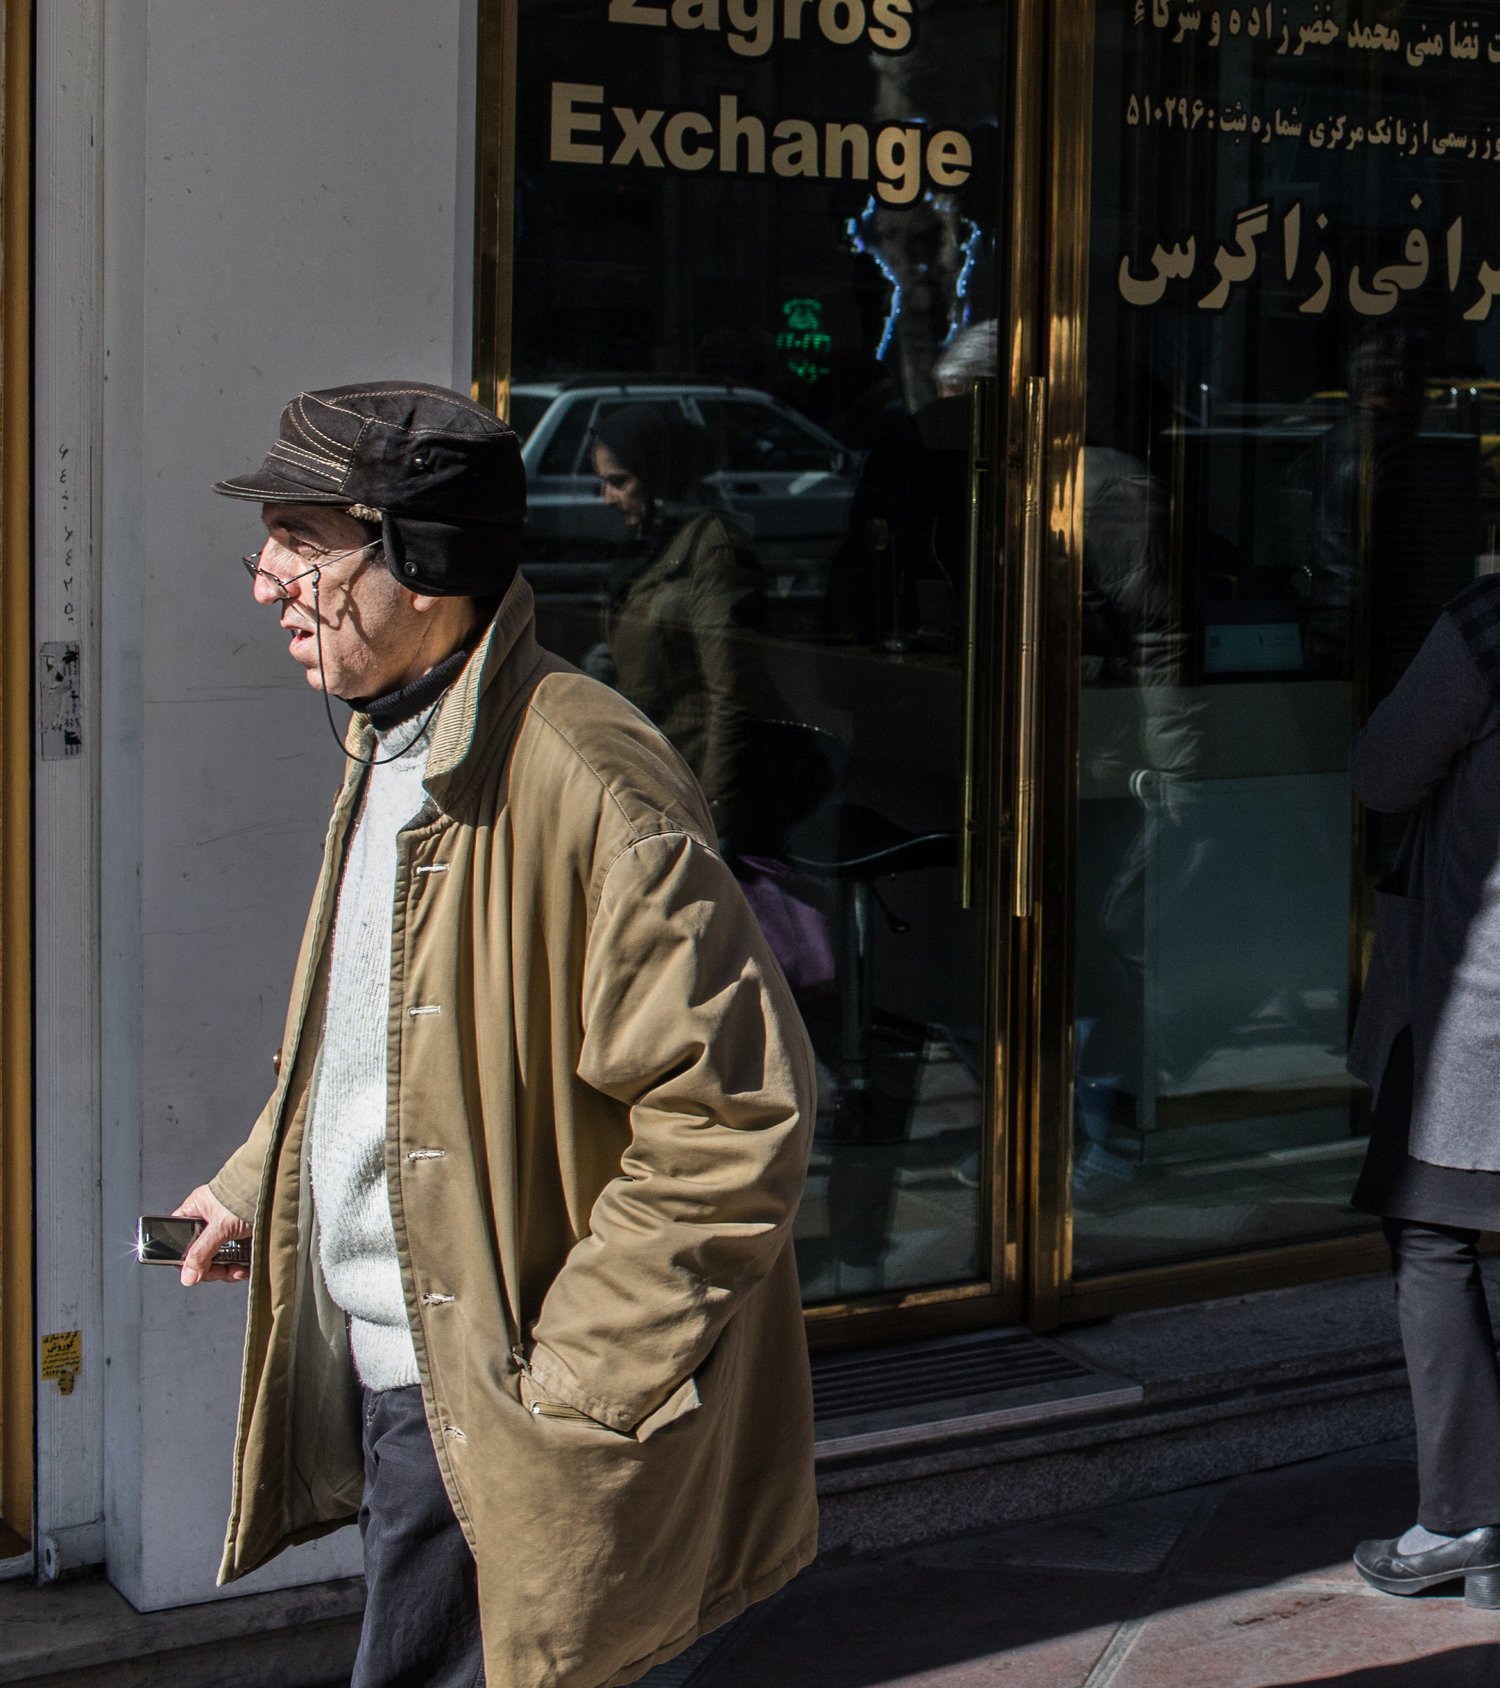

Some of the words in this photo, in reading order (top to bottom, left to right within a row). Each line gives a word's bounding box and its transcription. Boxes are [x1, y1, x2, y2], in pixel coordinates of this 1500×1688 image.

[1208, 10, 1221, 47] و
[1347, 18, 1400, 52] محمد
[550, 82, 973, 204] Exchange
[1251, 105, 1303, 144] شماره
[1308, 114, 1364, 151] مرکزی
[1432, 132, 1477, 159] رسمی
[1118, 201, 1332, 314] زاگرس
